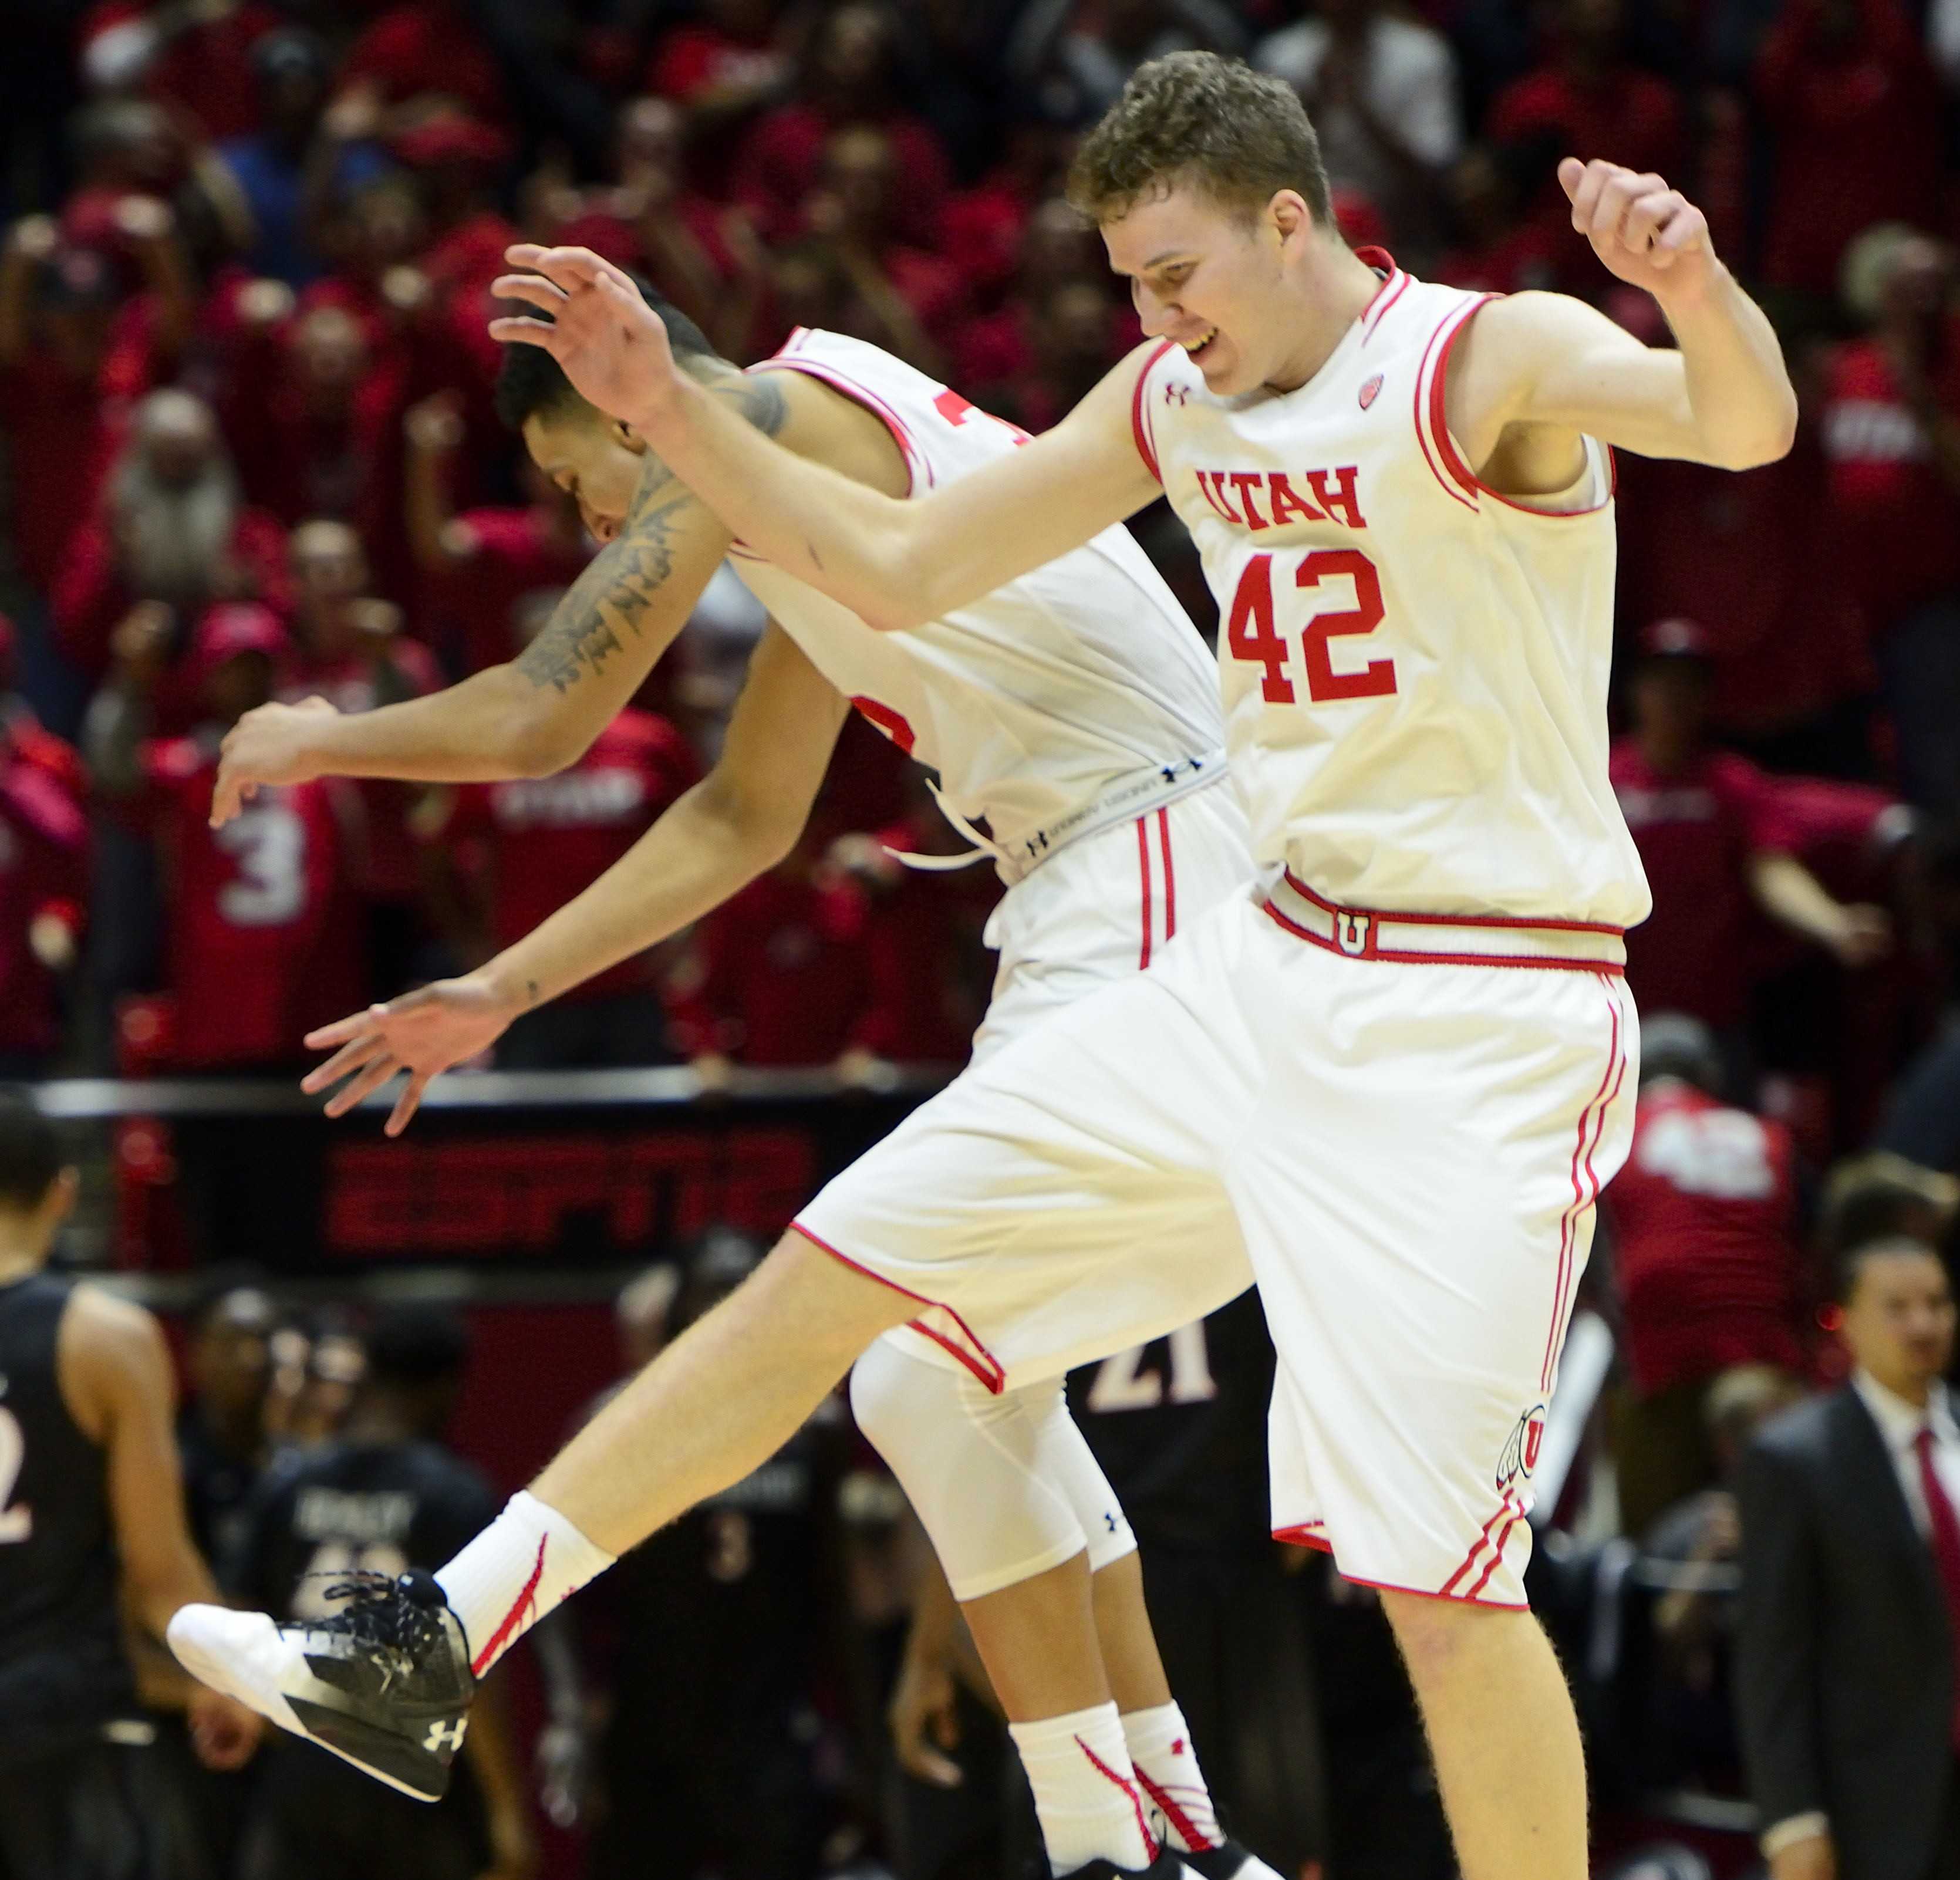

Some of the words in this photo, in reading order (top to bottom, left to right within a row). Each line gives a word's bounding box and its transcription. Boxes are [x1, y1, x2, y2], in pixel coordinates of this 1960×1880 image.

[1196, 465, 1368, 531] UTAH
[1228, 548, 1398, 704] 42
[212, 805, 309, 929] 3
[1337, 911, 1371, 956] U
[1525, 1419, 1545, 1469] U
